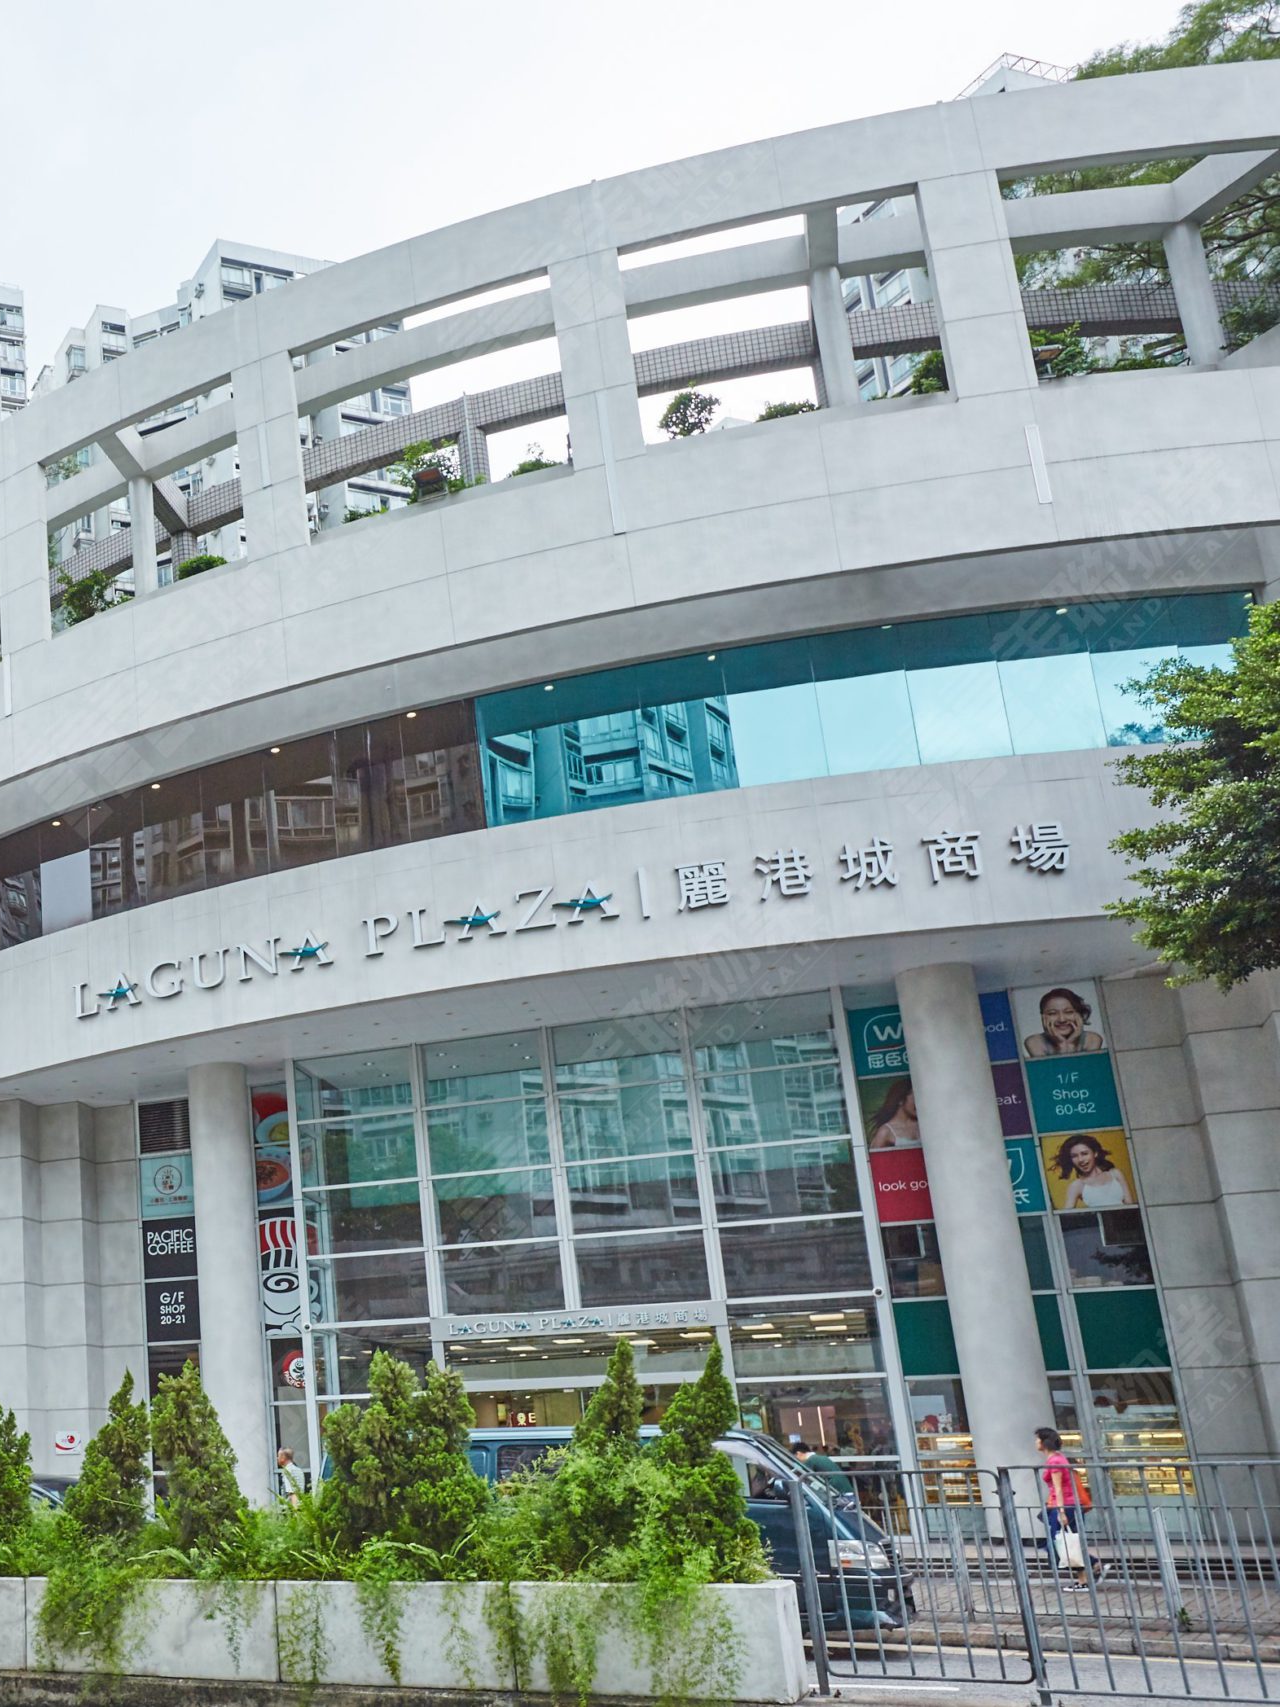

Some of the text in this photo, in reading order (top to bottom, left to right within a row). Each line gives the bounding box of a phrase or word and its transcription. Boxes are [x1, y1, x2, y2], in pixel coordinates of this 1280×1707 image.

[71, 820, 1071, 1020] LAGUNA PLAZA 麗港城商場
[868, 1051, 910, 1069] 屈臣
[1056, 1072, 1080, 1085] 1/F
[1052, 1087, 1089, 1103] Shop
[1055, 1101, 1096, 1116] 60-62
[878, 1179, 928, 1192] look go
[147, 1228, 193, 1244] PACIFIC
[147, 1241, 194, 1256] COFFEE
[159, 1291, 185, 1304] G/F
[159, 1304, 186, 1314] SHOP
[160, 1314, 186, 1325] 20-21
[448, 1308, 709, 1336] LAGUNA PLAZA 麗港城商場
